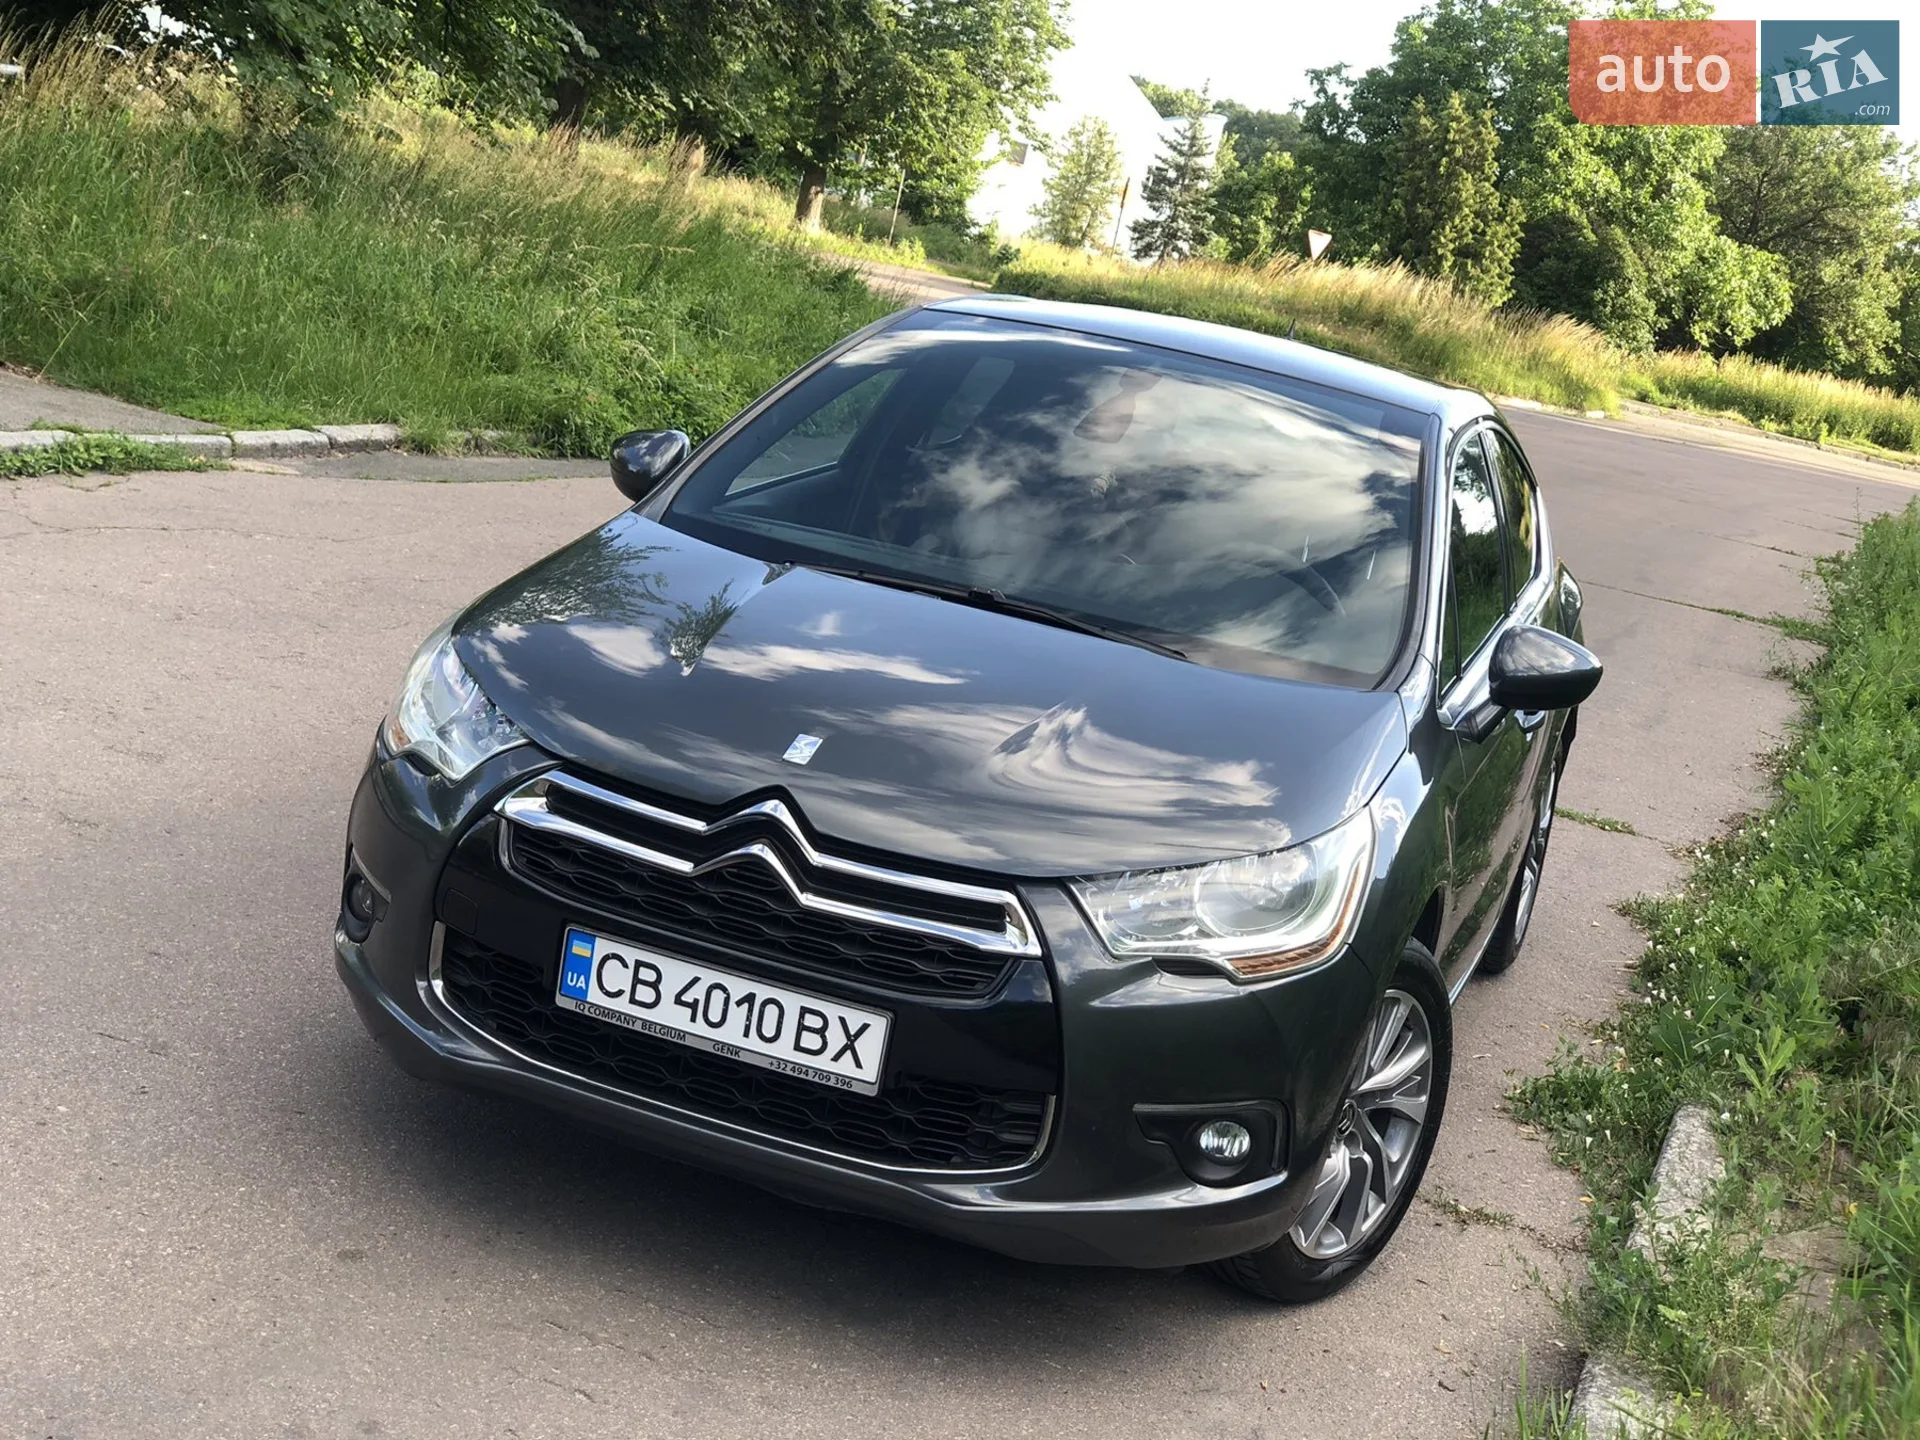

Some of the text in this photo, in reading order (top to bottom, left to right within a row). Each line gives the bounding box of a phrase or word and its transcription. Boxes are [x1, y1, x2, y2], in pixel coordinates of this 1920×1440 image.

[567, 971, 587, 991] UA
[596, 952, 871, 1070] CB 4010 BX
[574, 1001, 853, 1089] IQ COMPANY BELGIUM GENK +32 494 709 396
